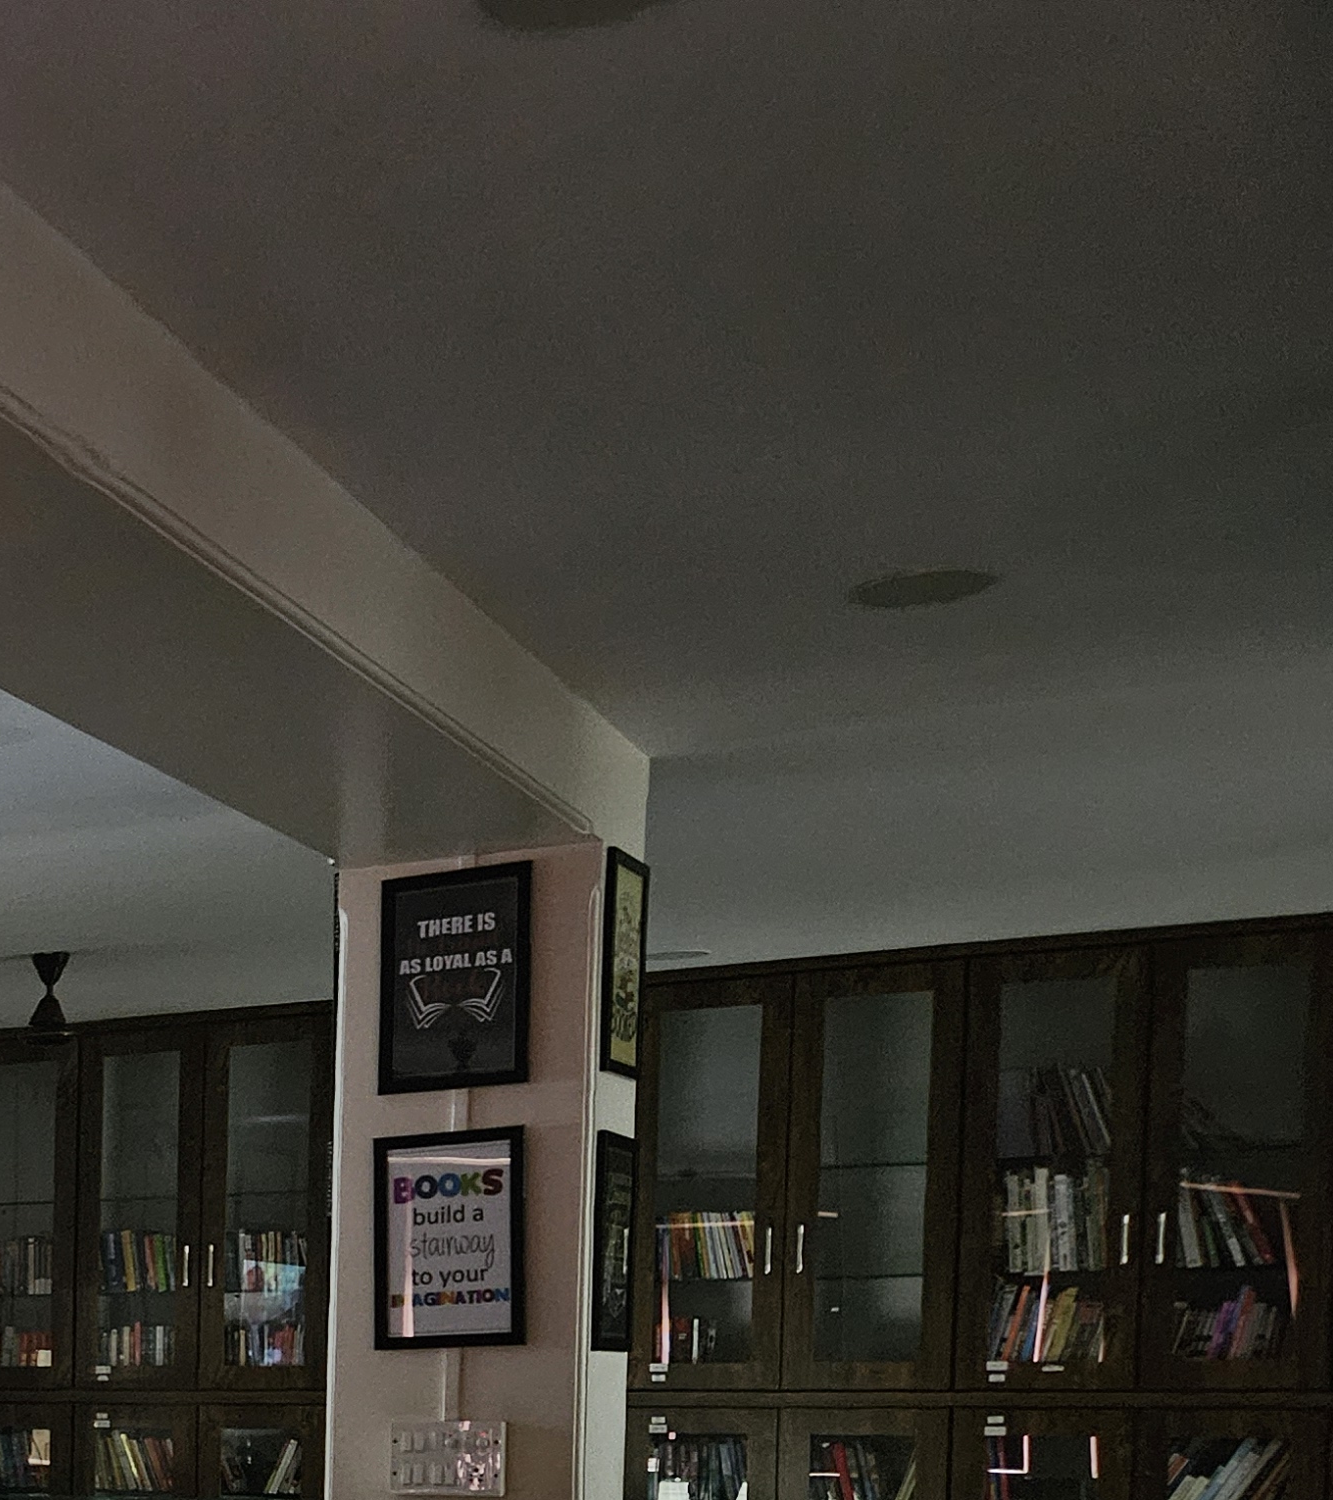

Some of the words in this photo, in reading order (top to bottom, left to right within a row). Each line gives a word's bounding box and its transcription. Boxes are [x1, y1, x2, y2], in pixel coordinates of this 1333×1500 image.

[417, 914, 473, 939] THERE
[477, 911, 496, 932] IS
[399, 958, 421, 975] AS
[425, 952, 471, 973] LOYAL
[474, 949, 497, 967] AS
[501, 948, 513, 965] A
[393, 1168, 504, 1204] BOOKS
[413, 1205, 465, 1226] build
[472, 1207, 484, 1222] a
[409, 1233, 495, 1268] stairway
[412, 1269, 433, 1286] to
[438, 1265, 489, 1289] your
